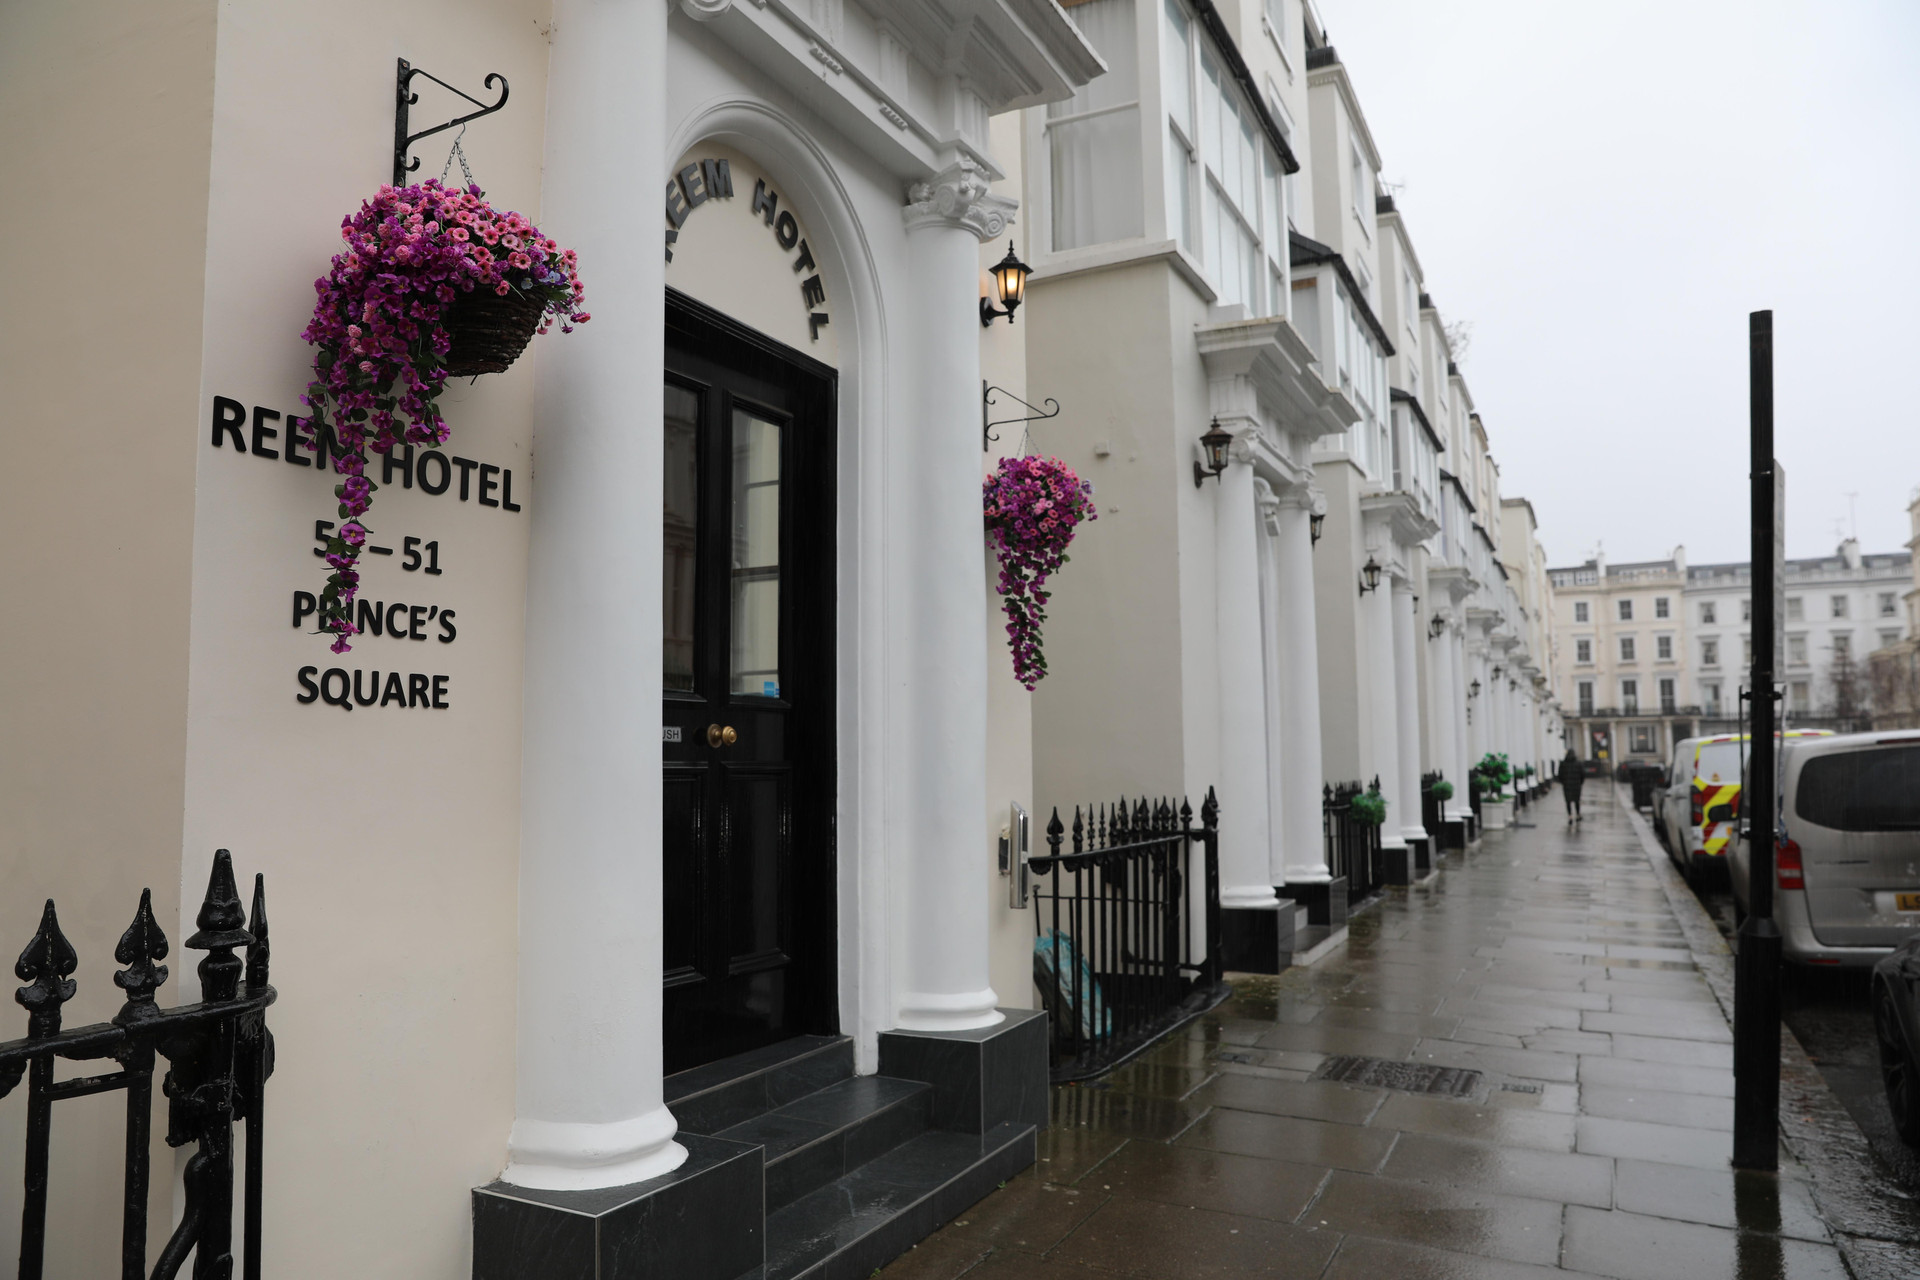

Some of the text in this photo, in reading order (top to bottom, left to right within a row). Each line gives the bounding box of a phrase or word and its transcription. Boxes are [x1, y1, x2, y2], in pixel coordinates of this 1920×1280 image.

[666, 159, 829, 340] EEM HOTEL
[382, 444, 521, 512] HOTEL
[402, 536, 442, 575] 51
[296, 665, 449, 711] SQUARE
